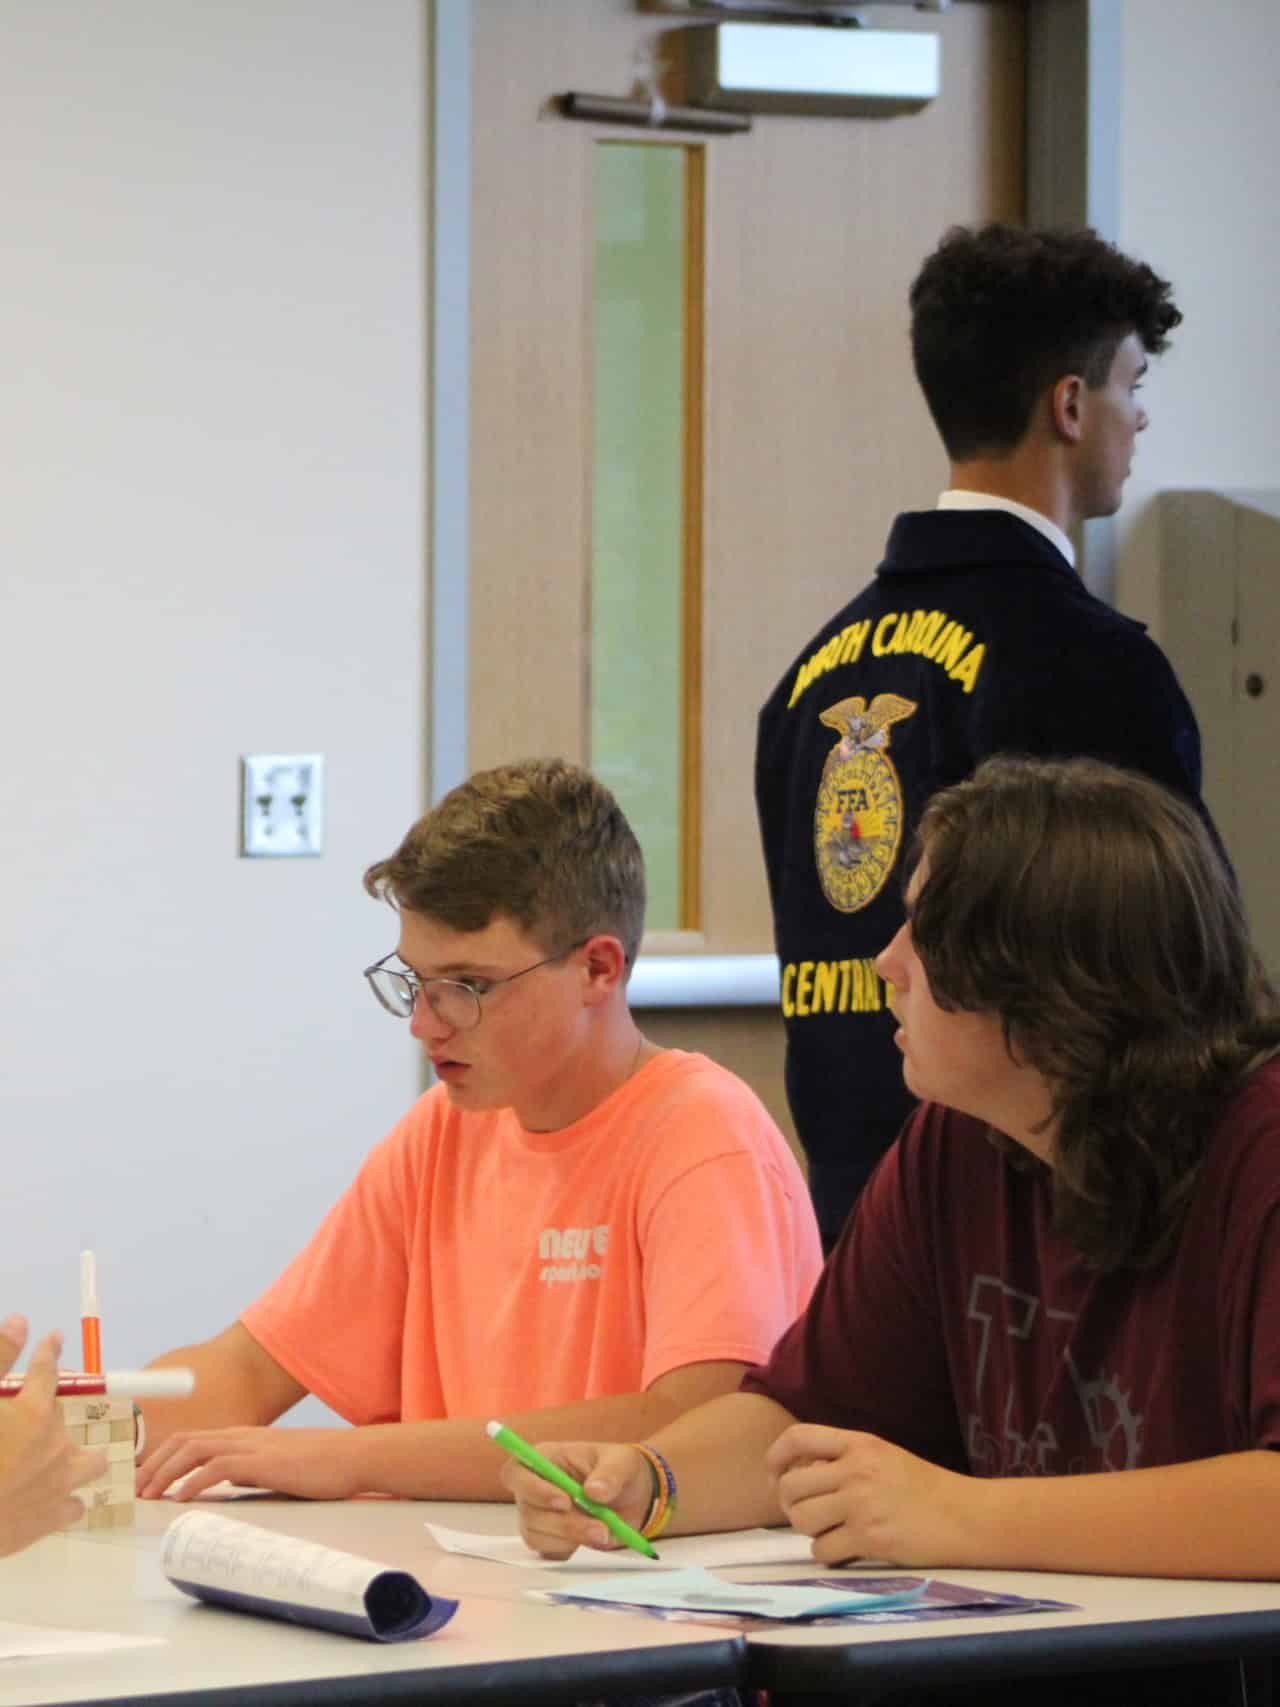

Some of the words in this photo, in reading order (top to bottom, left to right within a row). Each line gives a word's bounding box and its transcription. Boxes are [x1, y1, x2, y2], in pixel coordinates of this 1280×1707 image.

[786, 618, 871, 709] NORTH
[871, 609, 985, 694] CAROLINA
[836, 788, 870, 814] FFA
